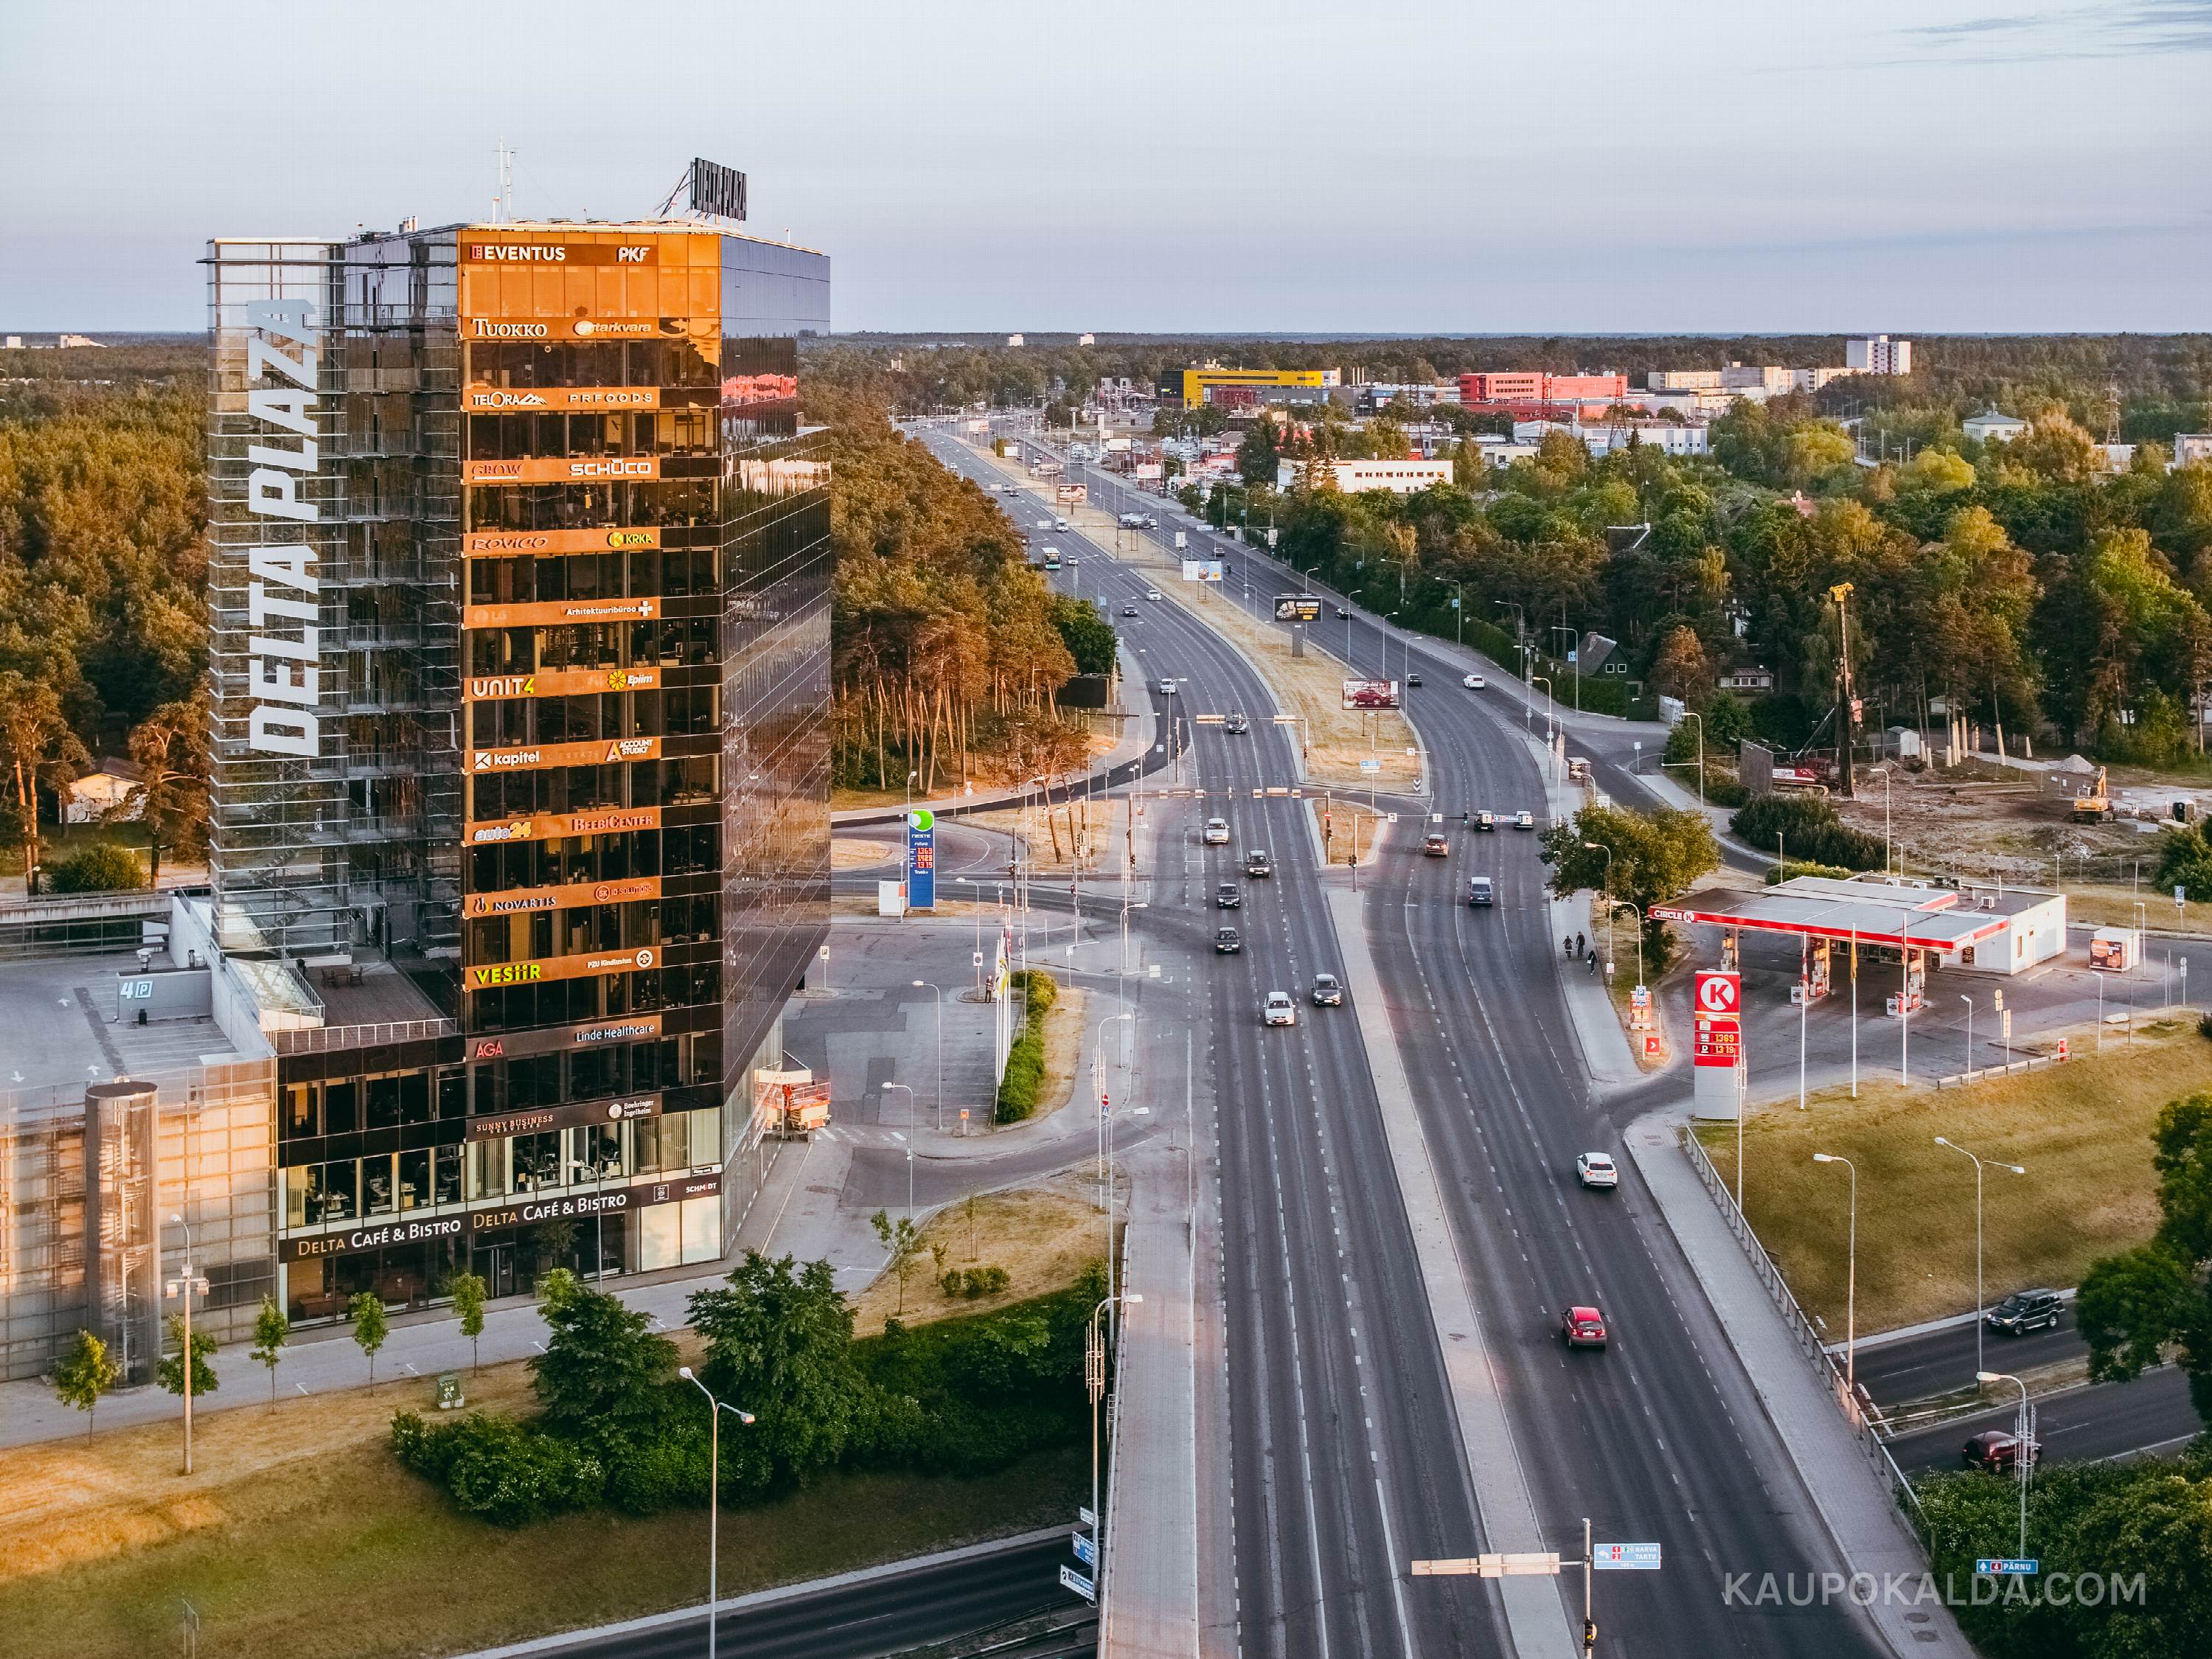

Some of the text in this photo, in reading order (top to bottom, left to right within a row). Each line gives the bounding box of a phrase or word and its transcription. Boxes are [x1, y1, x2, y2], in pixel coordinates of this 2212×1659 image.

[484, 246, 566, 262] EVENTUS
[618, 246, 650, 262] PKF
[472, 463, 524, 476] GROW
[571, 459, 652, 476] SCHÜCO
[247, 298, 320, 758] DELTA PLAZA
[473, 537, 549, 550] ROVICO
[625, 534, 654, 545] KRKA
[566, 605, 636, 616] Arhitektuuribüroo
[619, 739, 653, 748] ACCOUNT
[622, 747, 647, 756] STUDIO
[493, 751, 540, 768] kapitel
[475, 821, 532, 841] auto24
[495, 897, 557, 911] NOVARTIS
[1654, 910, 1683, 921] CIRCLE
[120, 981, 134, 999] 4
[577, 1024, 655, 1042] Linde Healthcare
[476, 1040, 504, 1057] AGA
[624, 1099, 654, 1110] Boehringer
[624, 1108, 651, 1117] Ingelheim
[476, 1114, 554, 1133] SUNNY BUSINESS
[473, 1194, 627, 1229] DELTA CAFÉ & BISTRO
[299, 1220, 462, 1256] DELTA CAFÉ & BISTRO
[2003, 1562, 2031, 1571] PÄRNU
